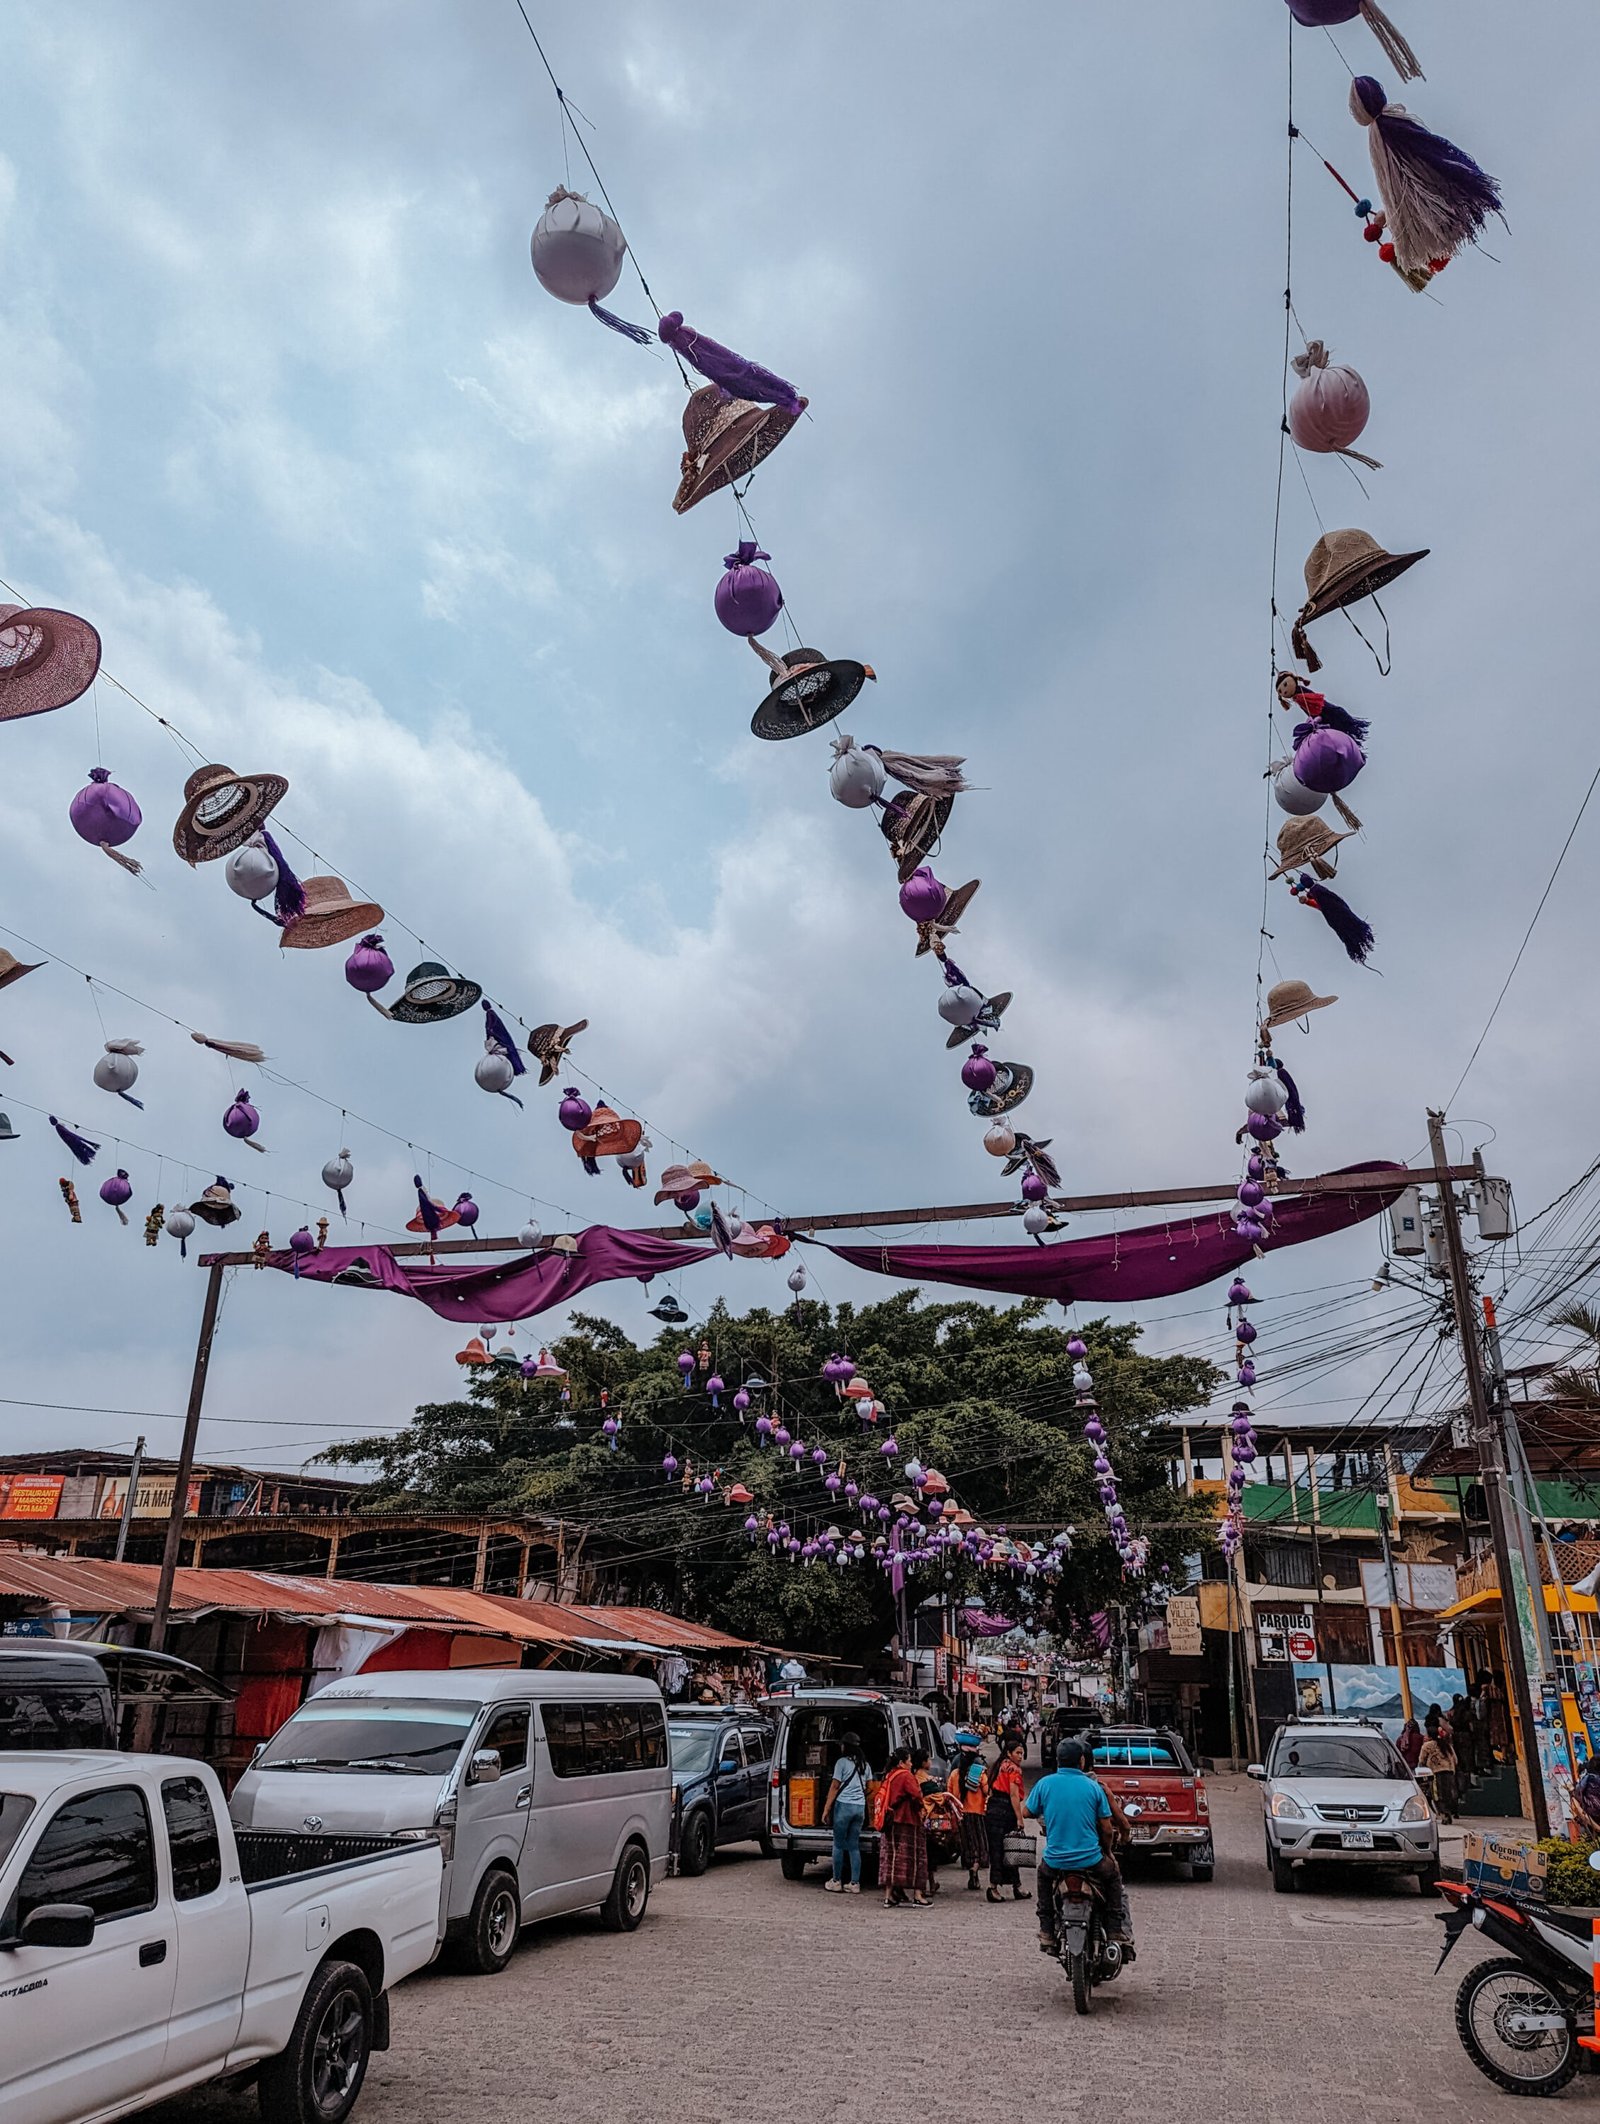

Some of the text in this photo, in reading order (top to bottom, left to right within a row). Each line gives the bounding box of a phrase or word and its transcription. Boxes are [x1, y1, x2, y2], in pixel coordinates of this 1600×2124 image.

[13, 1489, 60, 1497] RESTAURANTE
[19, 1497, 55, 1505] MARISCOS
[133, 1489, 150, 1508] LTA
[14, 1504, 48, 1513] ALTA MAR
[1170, 1600, 1196, 1610] HOTEL
[1171, 1609, 1195, 1619] VILLA
[1172, 1618, 1195, 1627] FLORES
[1260, 1614, 1311, 1629] PARQUEO
[1515, 1900, 1551, 1916] HONDA
[12, 1978, 48, 1997] TACOMA
